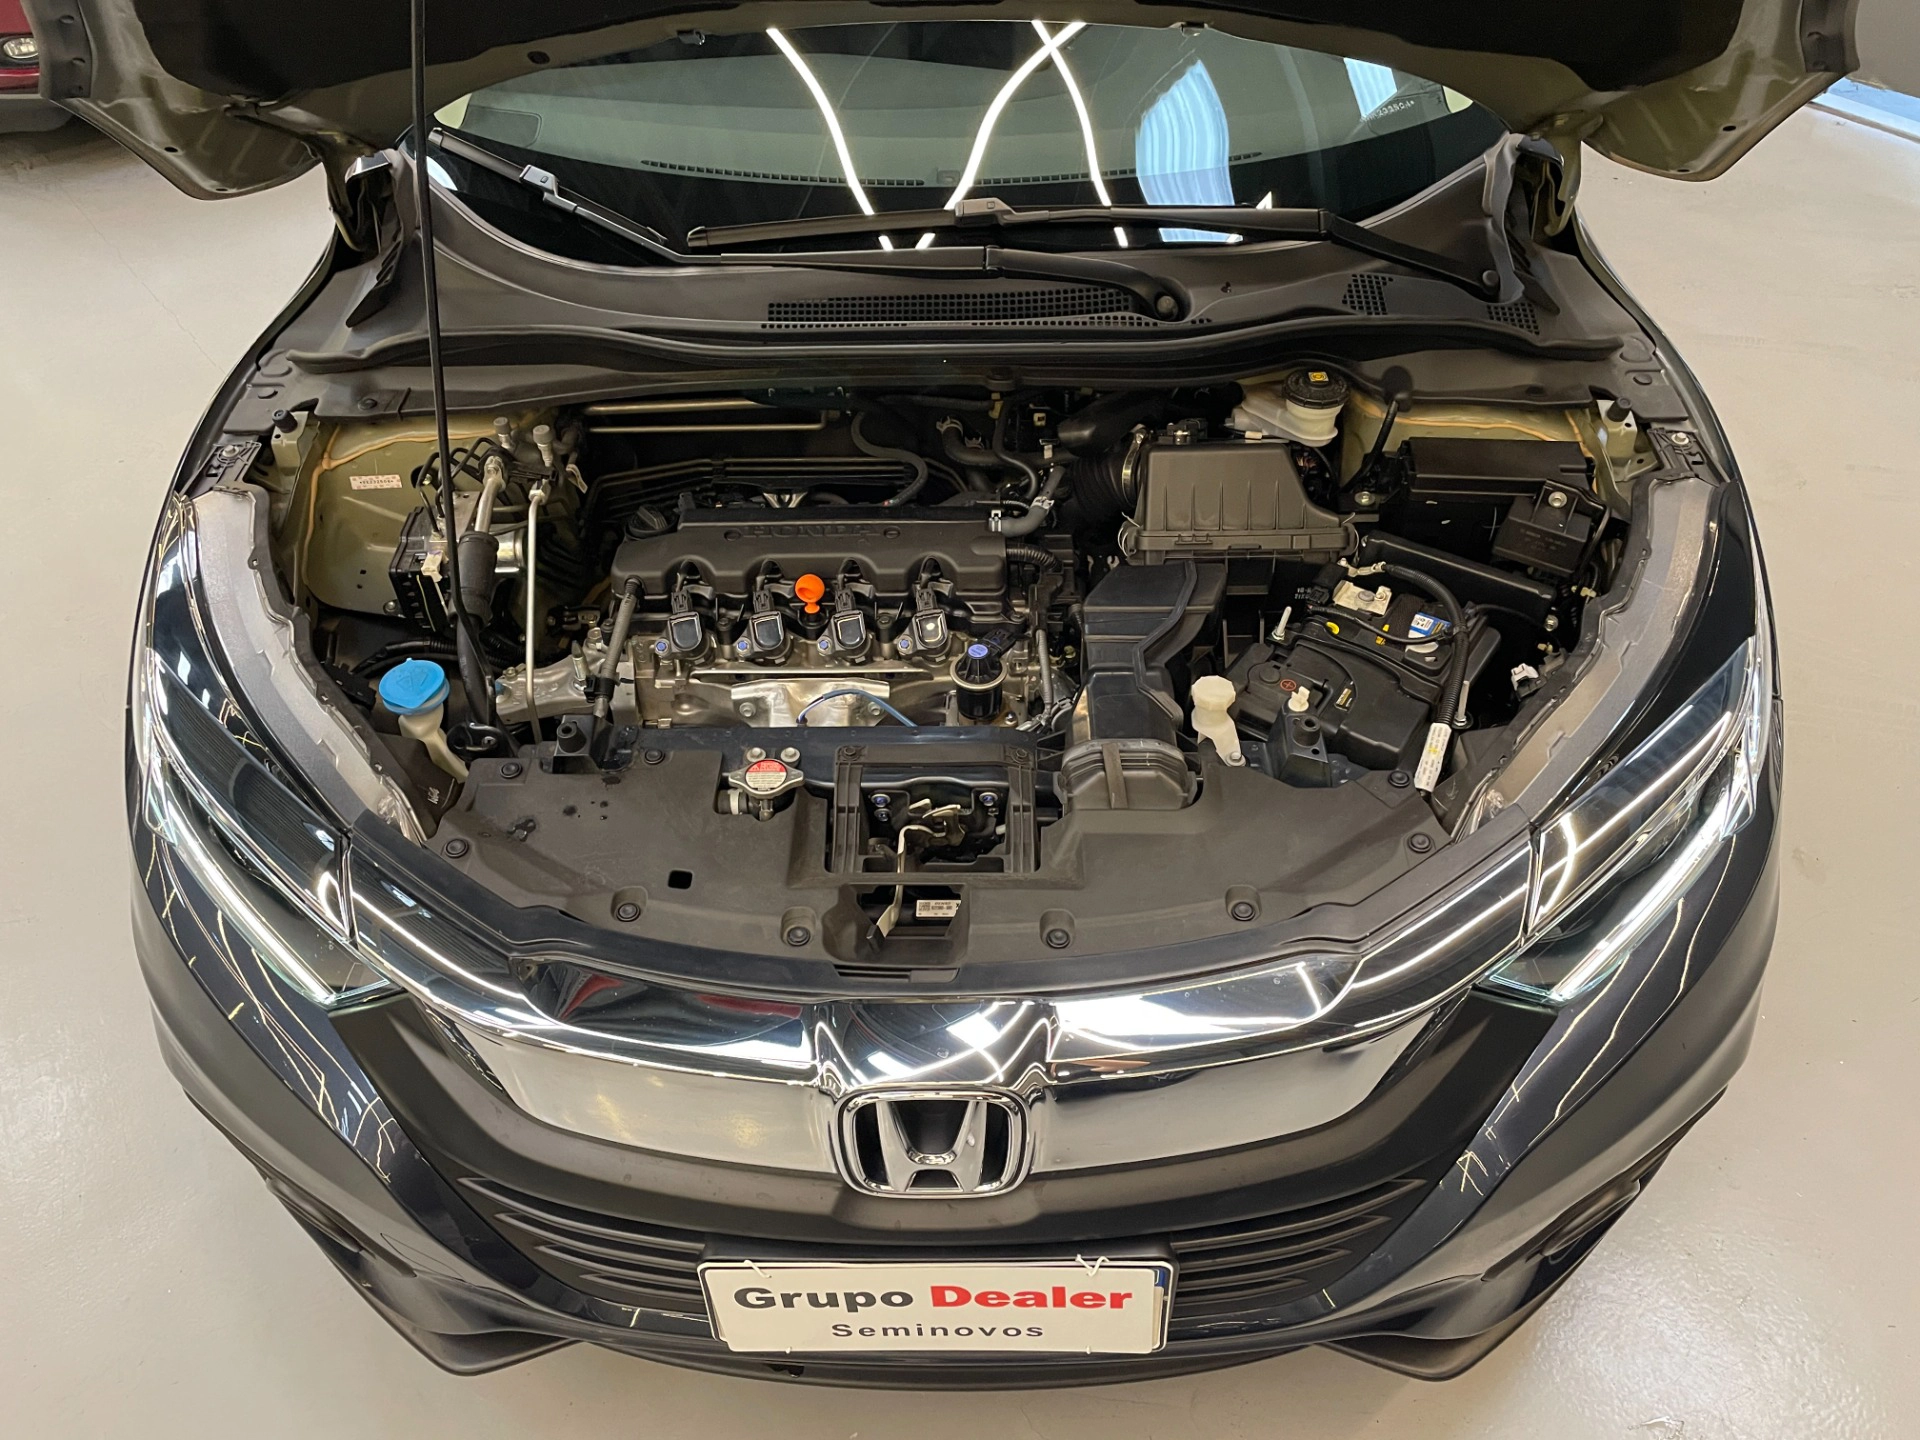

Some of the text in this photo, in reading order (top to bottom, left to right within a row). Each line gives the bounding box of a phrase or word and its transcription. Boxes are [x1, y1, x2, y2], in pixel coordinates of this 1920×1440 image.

[743, 524, 881, 538] HONDA
[733, 1285, 1133, 1313] Grupo Dealer
[832, 1323, 1044, 1338] Seminovos
